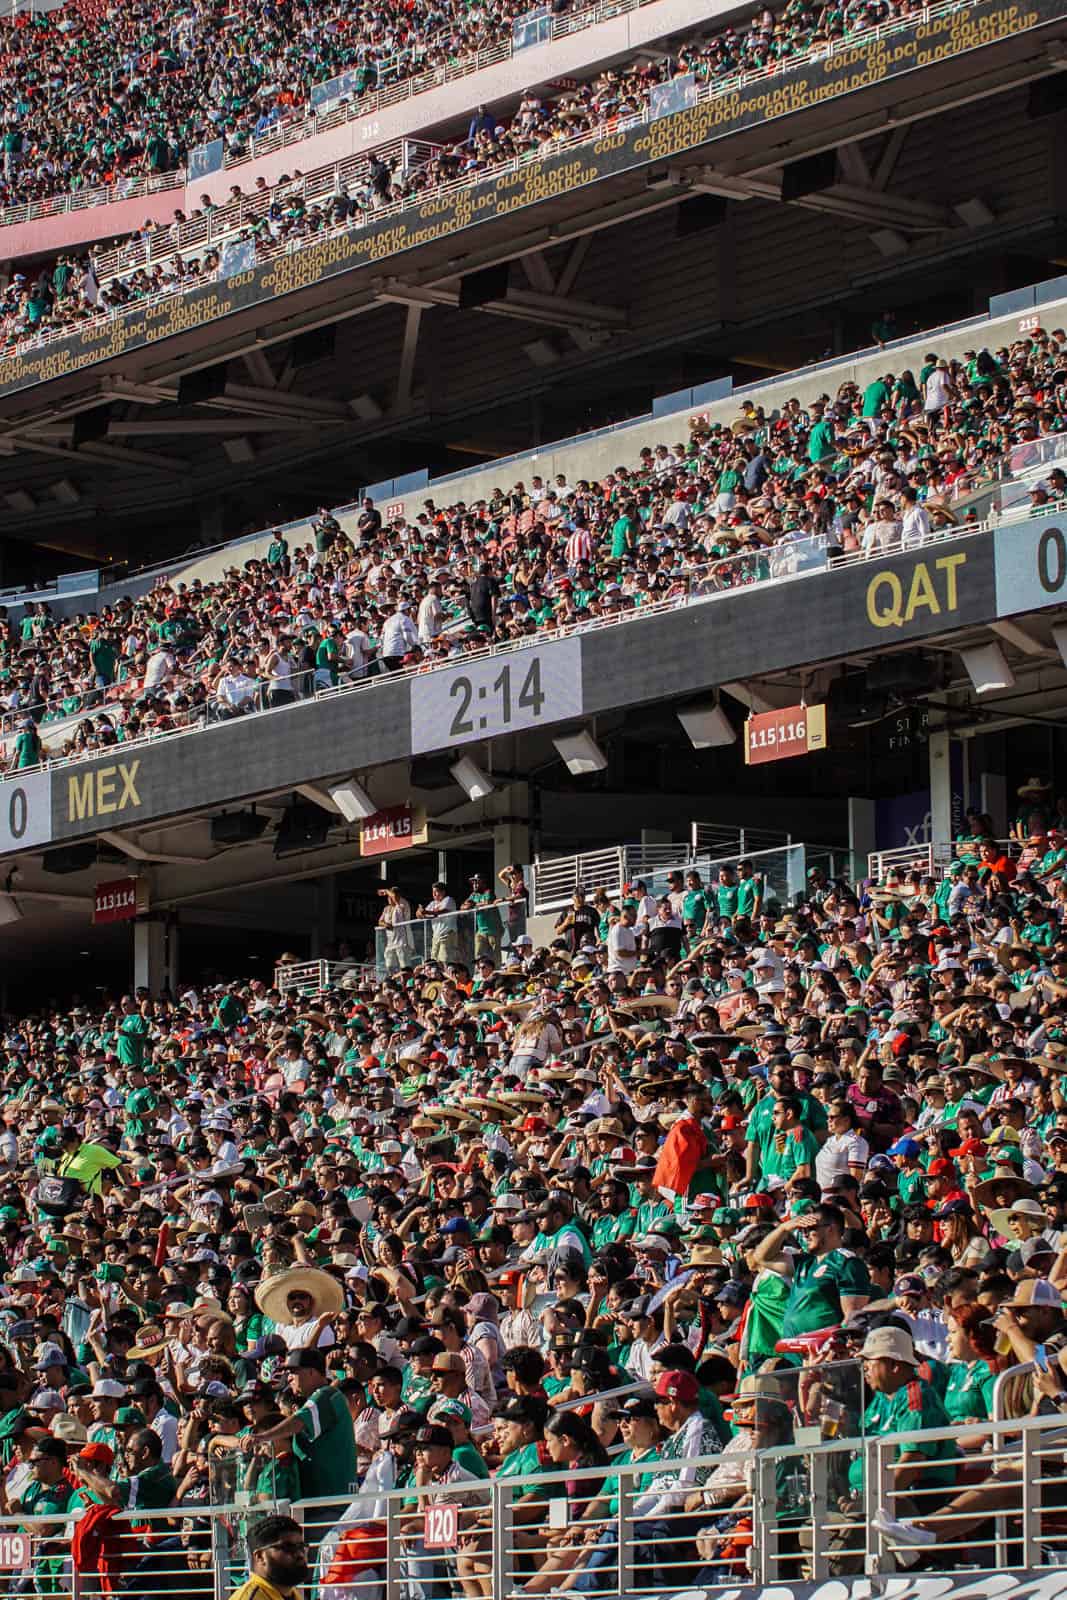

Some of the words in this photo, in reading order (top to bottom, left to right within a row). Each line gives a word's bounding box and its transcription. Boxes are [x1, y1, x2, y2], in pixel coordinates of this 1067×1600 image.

[1018, 315, 1038, 332] 215
[1038, 527, 1067, 593] 0
[866, 552, 967, 628] QAT
[450, 657, 545, 736] 2:14
[750, 727, 776, 749] 115
[778, 721, 805, 743] 116
[68, 760, 141, 822] MEX
[9, 787, 27, 839] 0
[364, 823, 387, 842] 114
[389, 817, 410, 837] 115
[96, 894, 114, 911] 113
[115, 889, 135, 907] 114
[428, 1508, 454, 1543] 120
